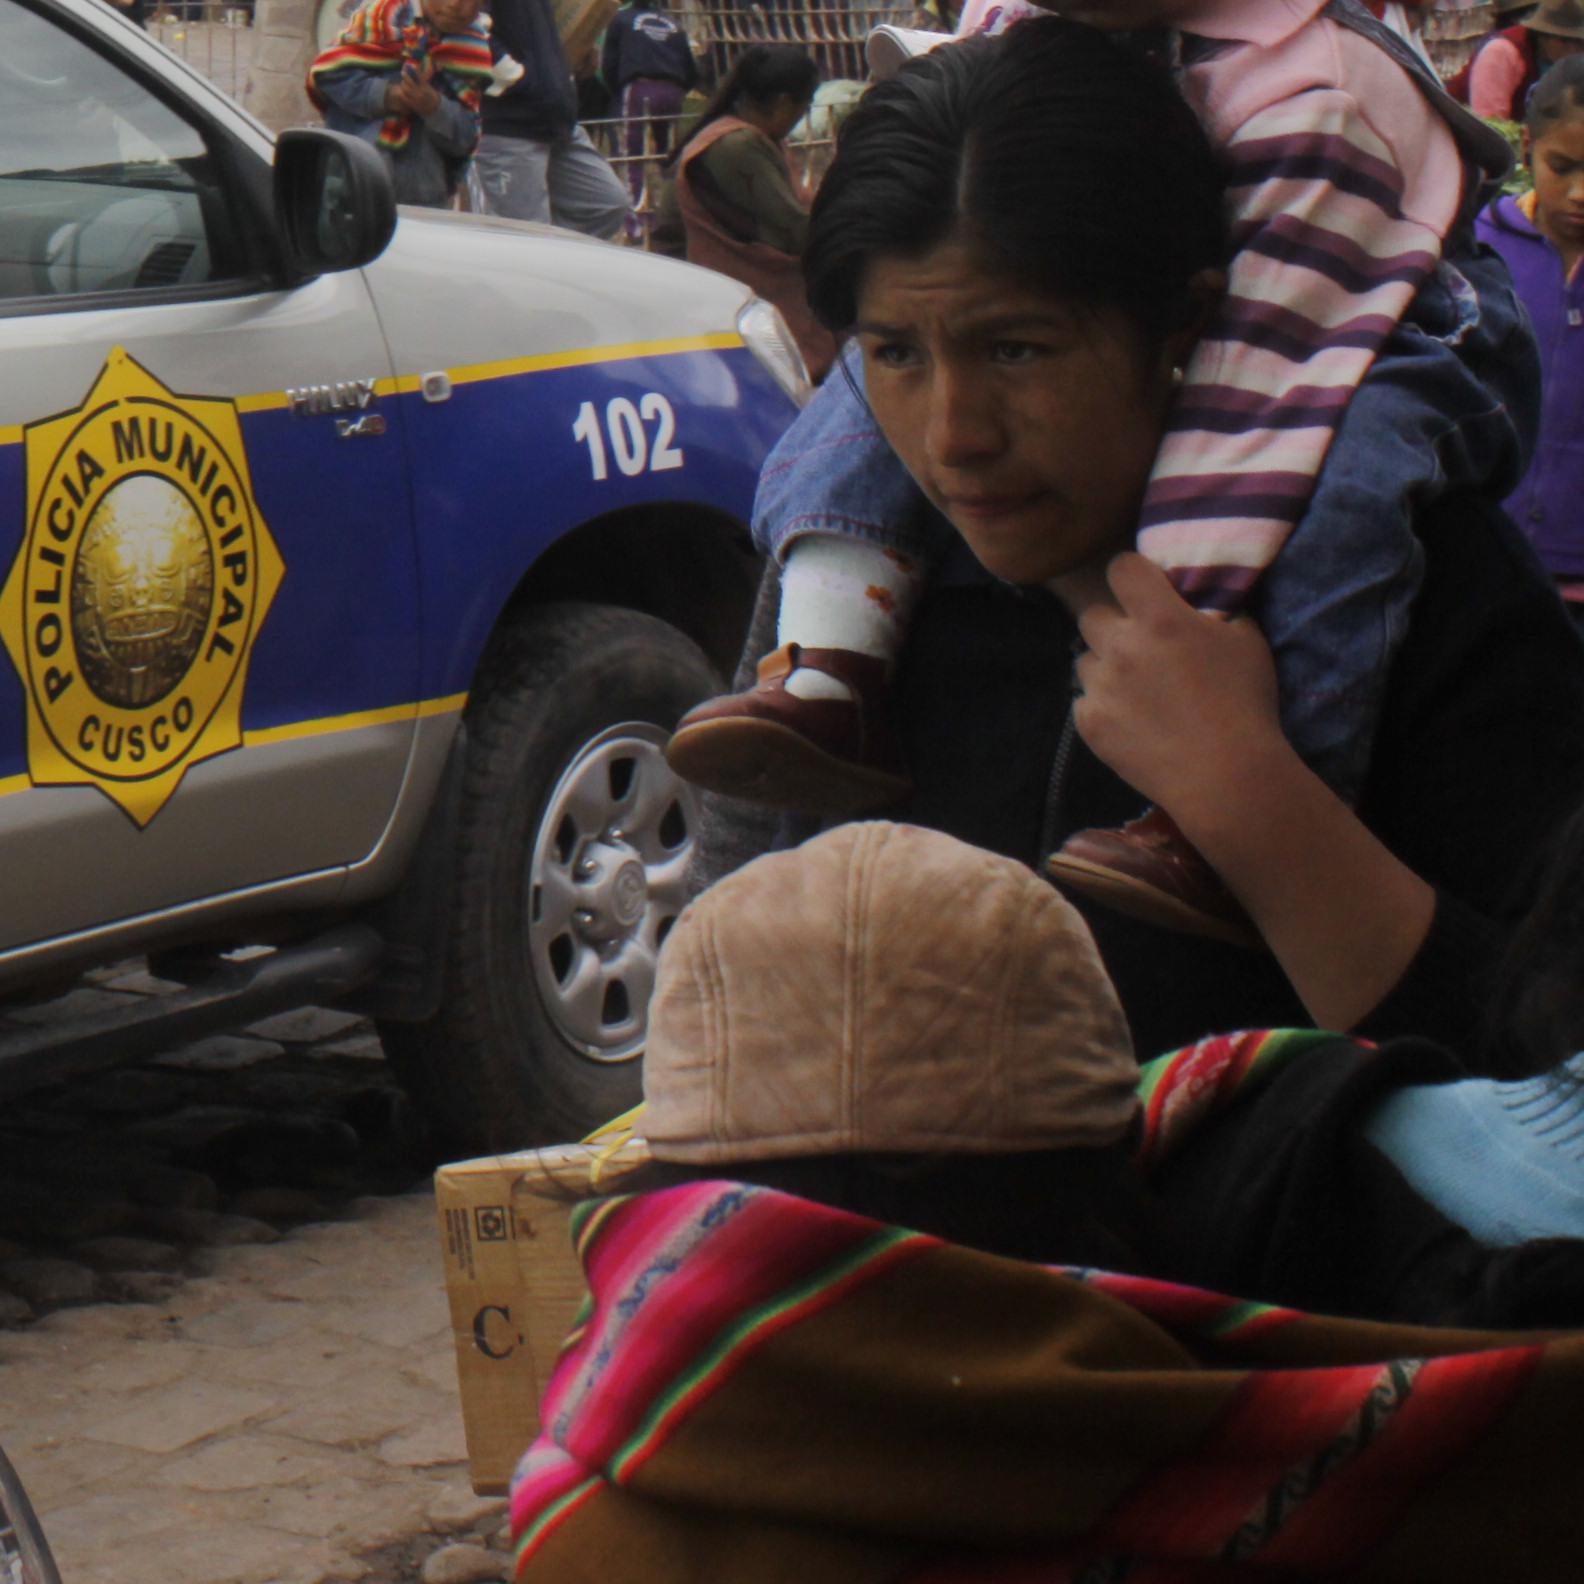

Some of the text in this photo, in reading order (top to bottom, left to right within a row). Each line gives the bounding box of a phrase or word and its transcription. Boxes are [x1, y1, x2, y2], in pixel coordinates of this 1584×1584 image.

[572, 392, 684, 481] 102
[34, 416, 250, 705] POLICIA MUNICIPAL
[77, 696, 194, 763] CUSCO
